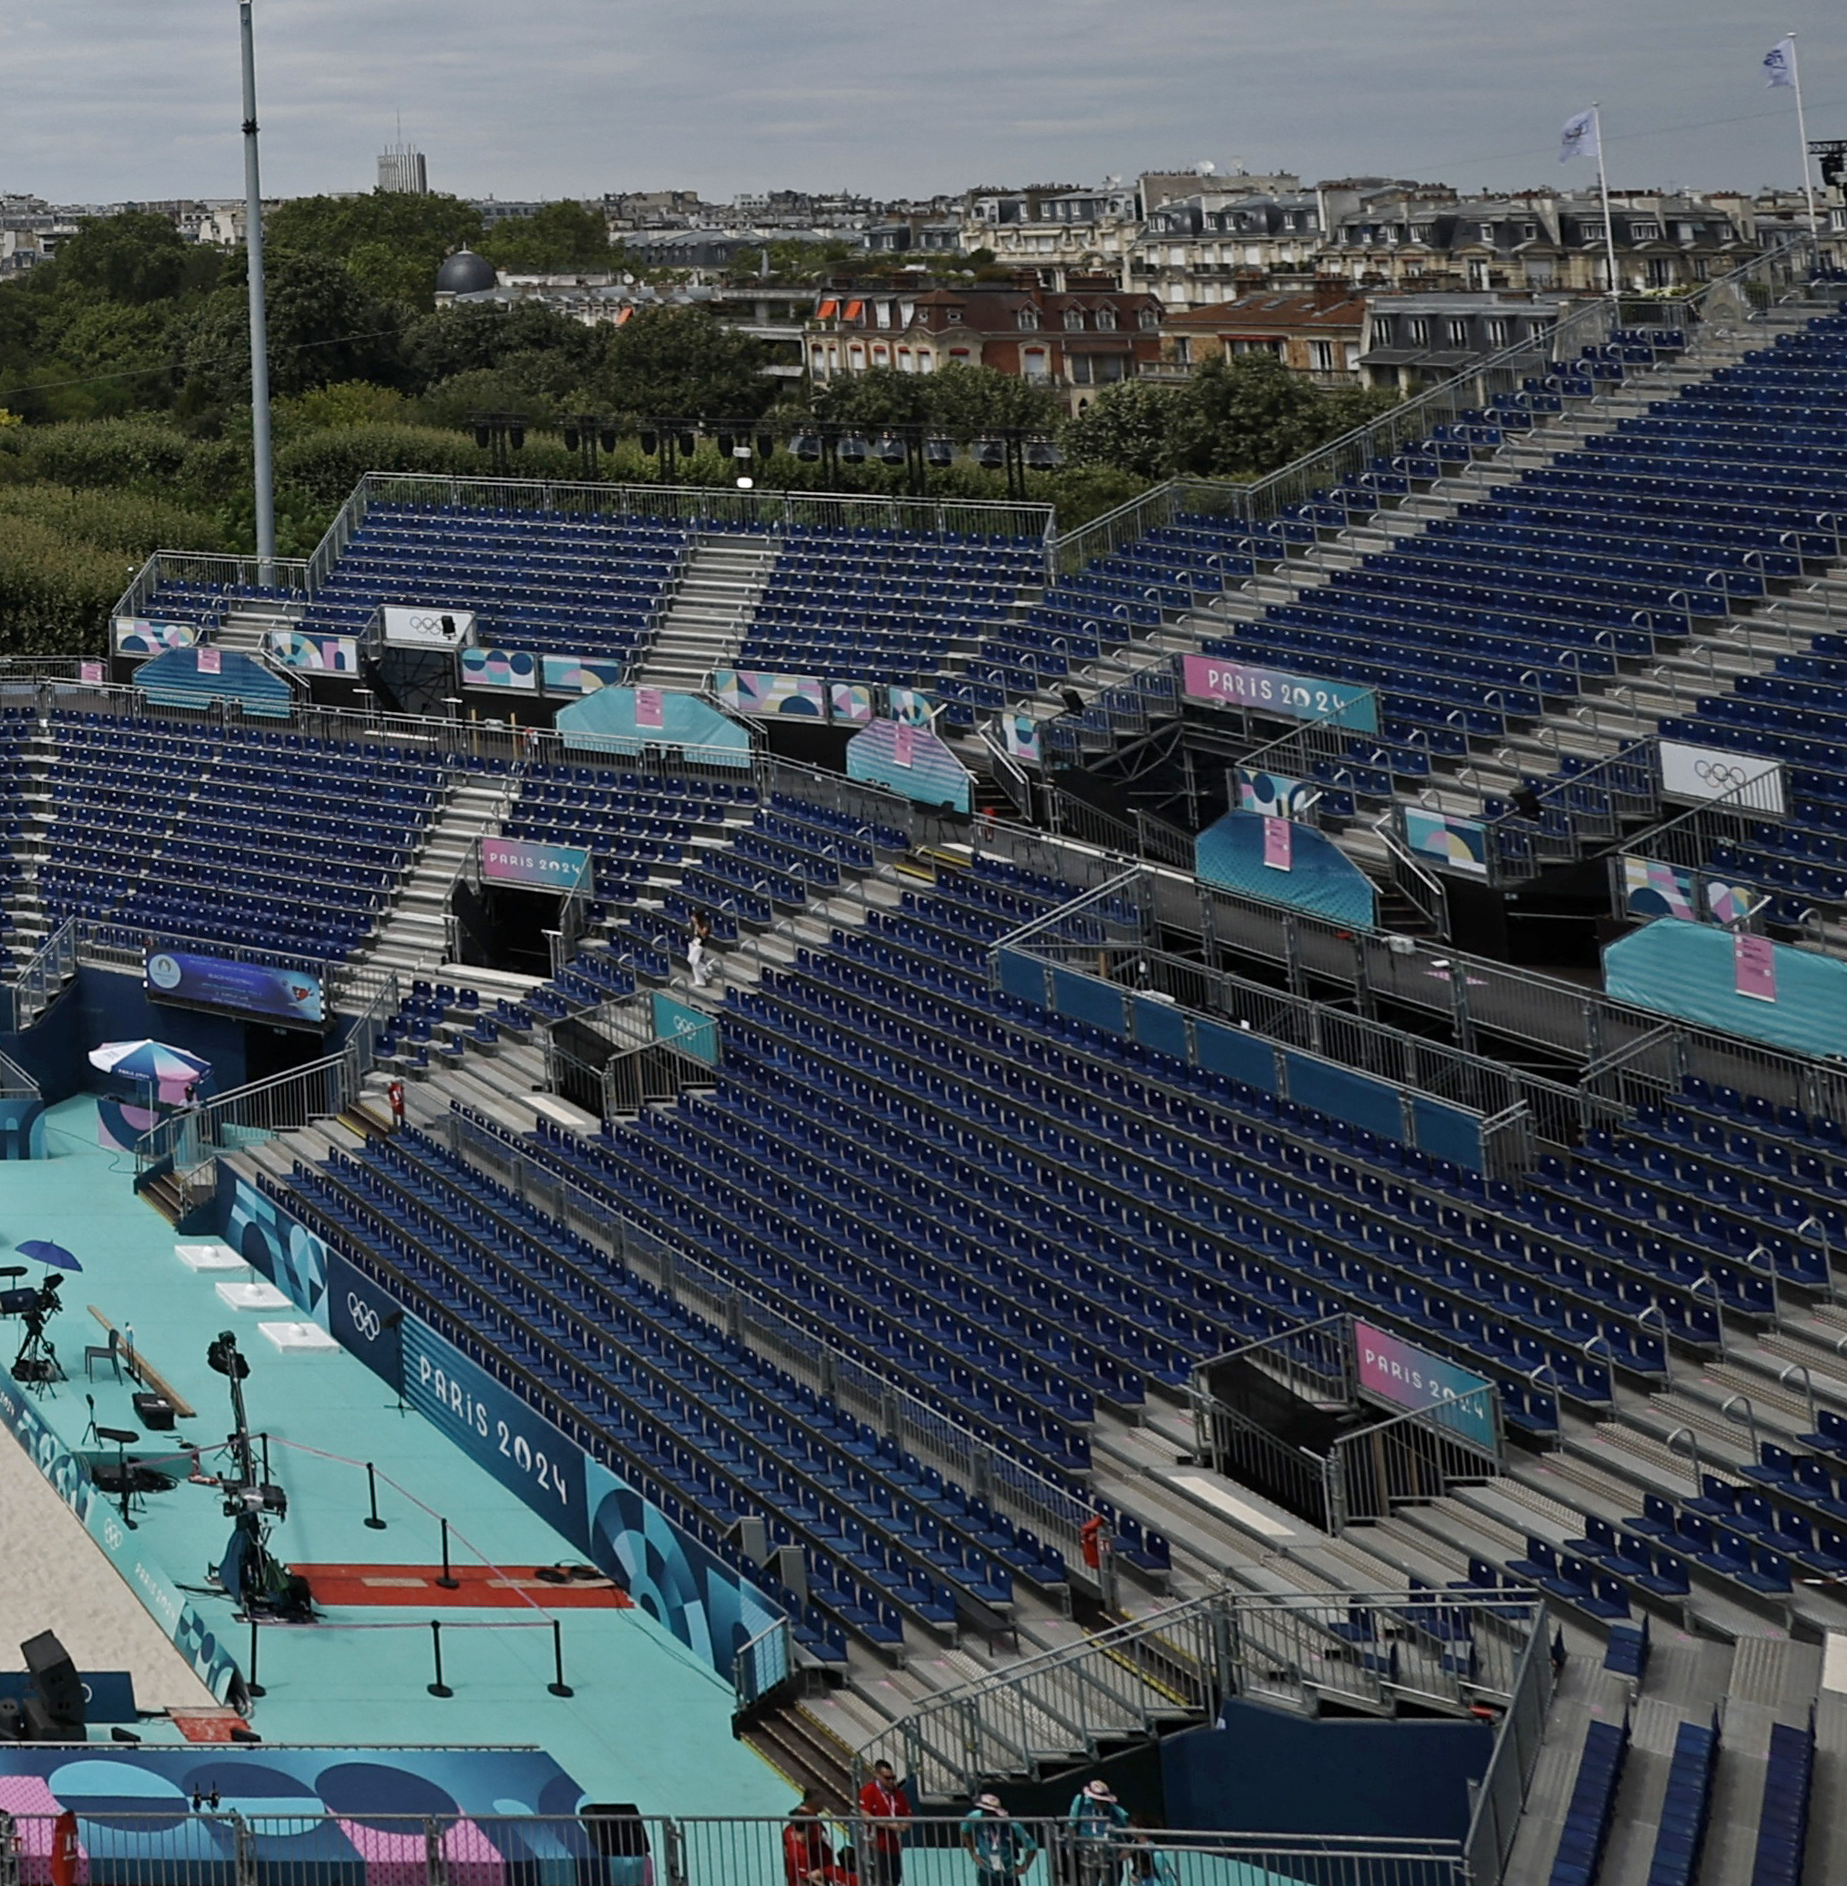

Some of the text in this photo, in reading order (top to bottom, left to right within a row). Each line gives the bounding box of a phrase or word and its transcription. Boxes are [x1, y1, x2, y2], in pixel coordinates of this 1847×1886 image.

[1280, 684, 1346, 715] 2024
[538, 859, 581, 875] 2024
[497, 1419, 567, 1505] 2024
